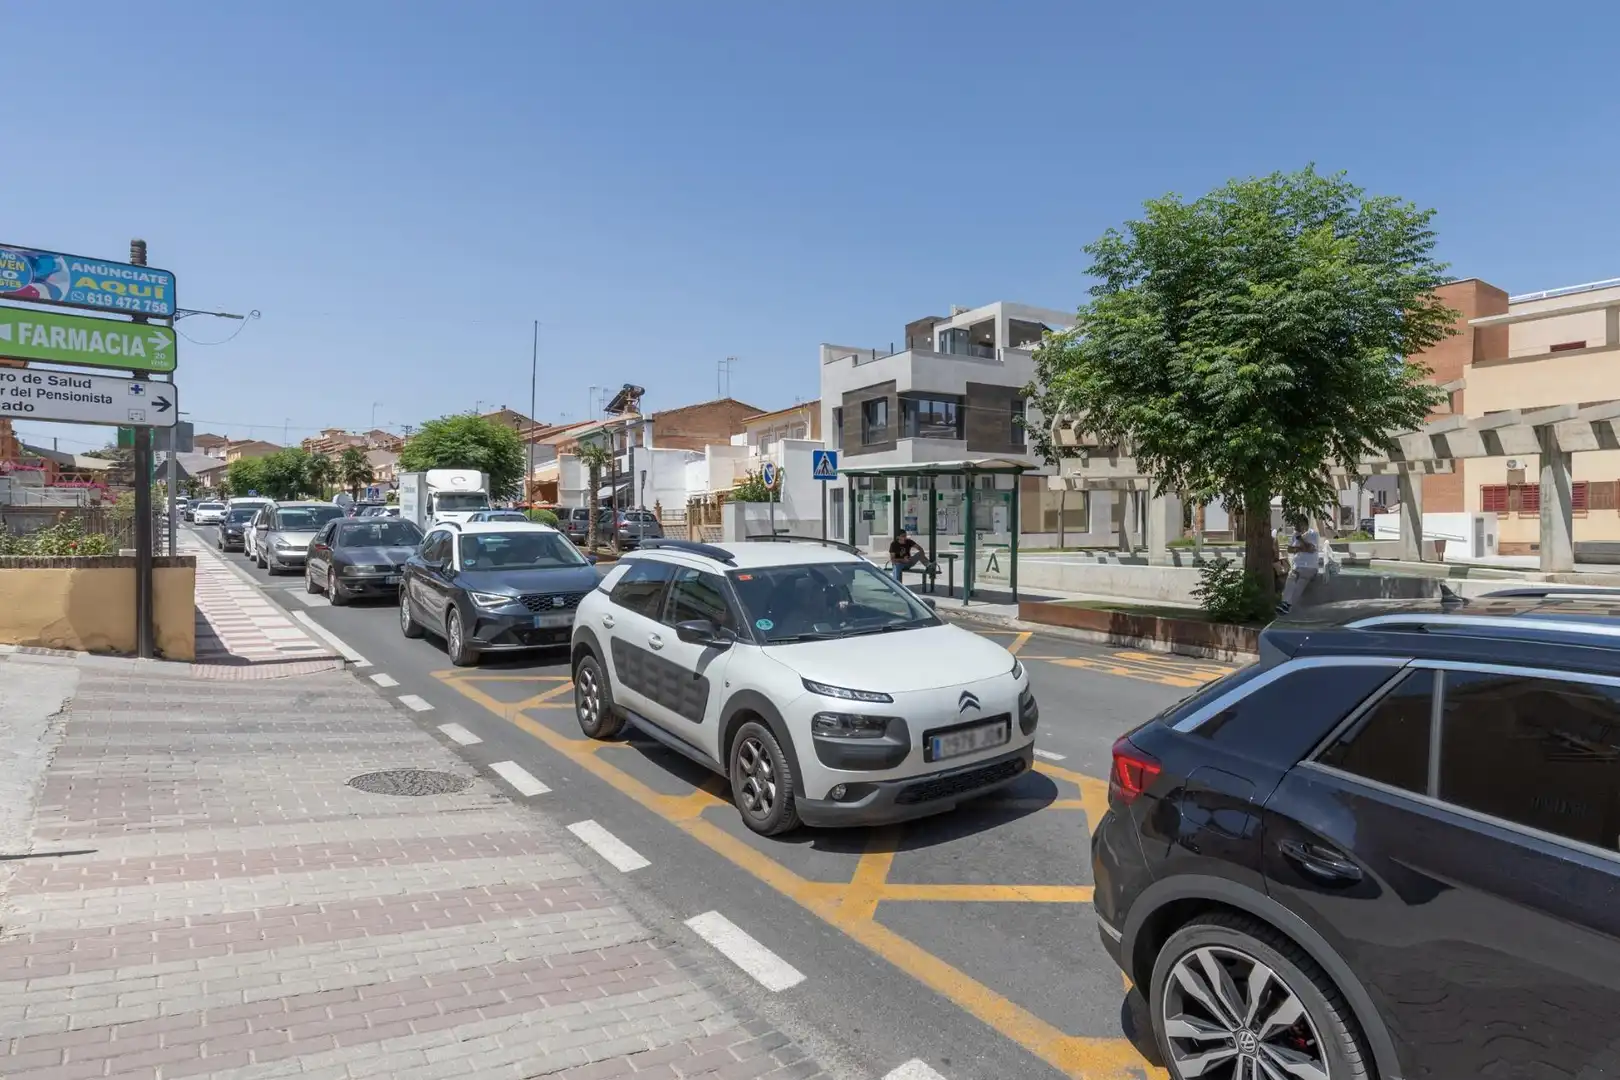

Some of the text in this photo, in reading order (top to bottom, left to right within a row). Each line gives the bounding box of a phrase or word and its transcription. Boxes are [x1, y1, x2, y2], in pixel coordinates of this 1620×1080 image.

[71, 262, 168, 285] ANÚNCIATE
[87, 292, 112, 306] 619
[115, 296, 140, 310] 472
[18, 322, 146, 357] FARMACIA
[22, 374, 42, 384] de
[48, 376, 92, 389] Salud
[10, 387, 31, 397] del
[36, 388, 113, 404] Pensionista
